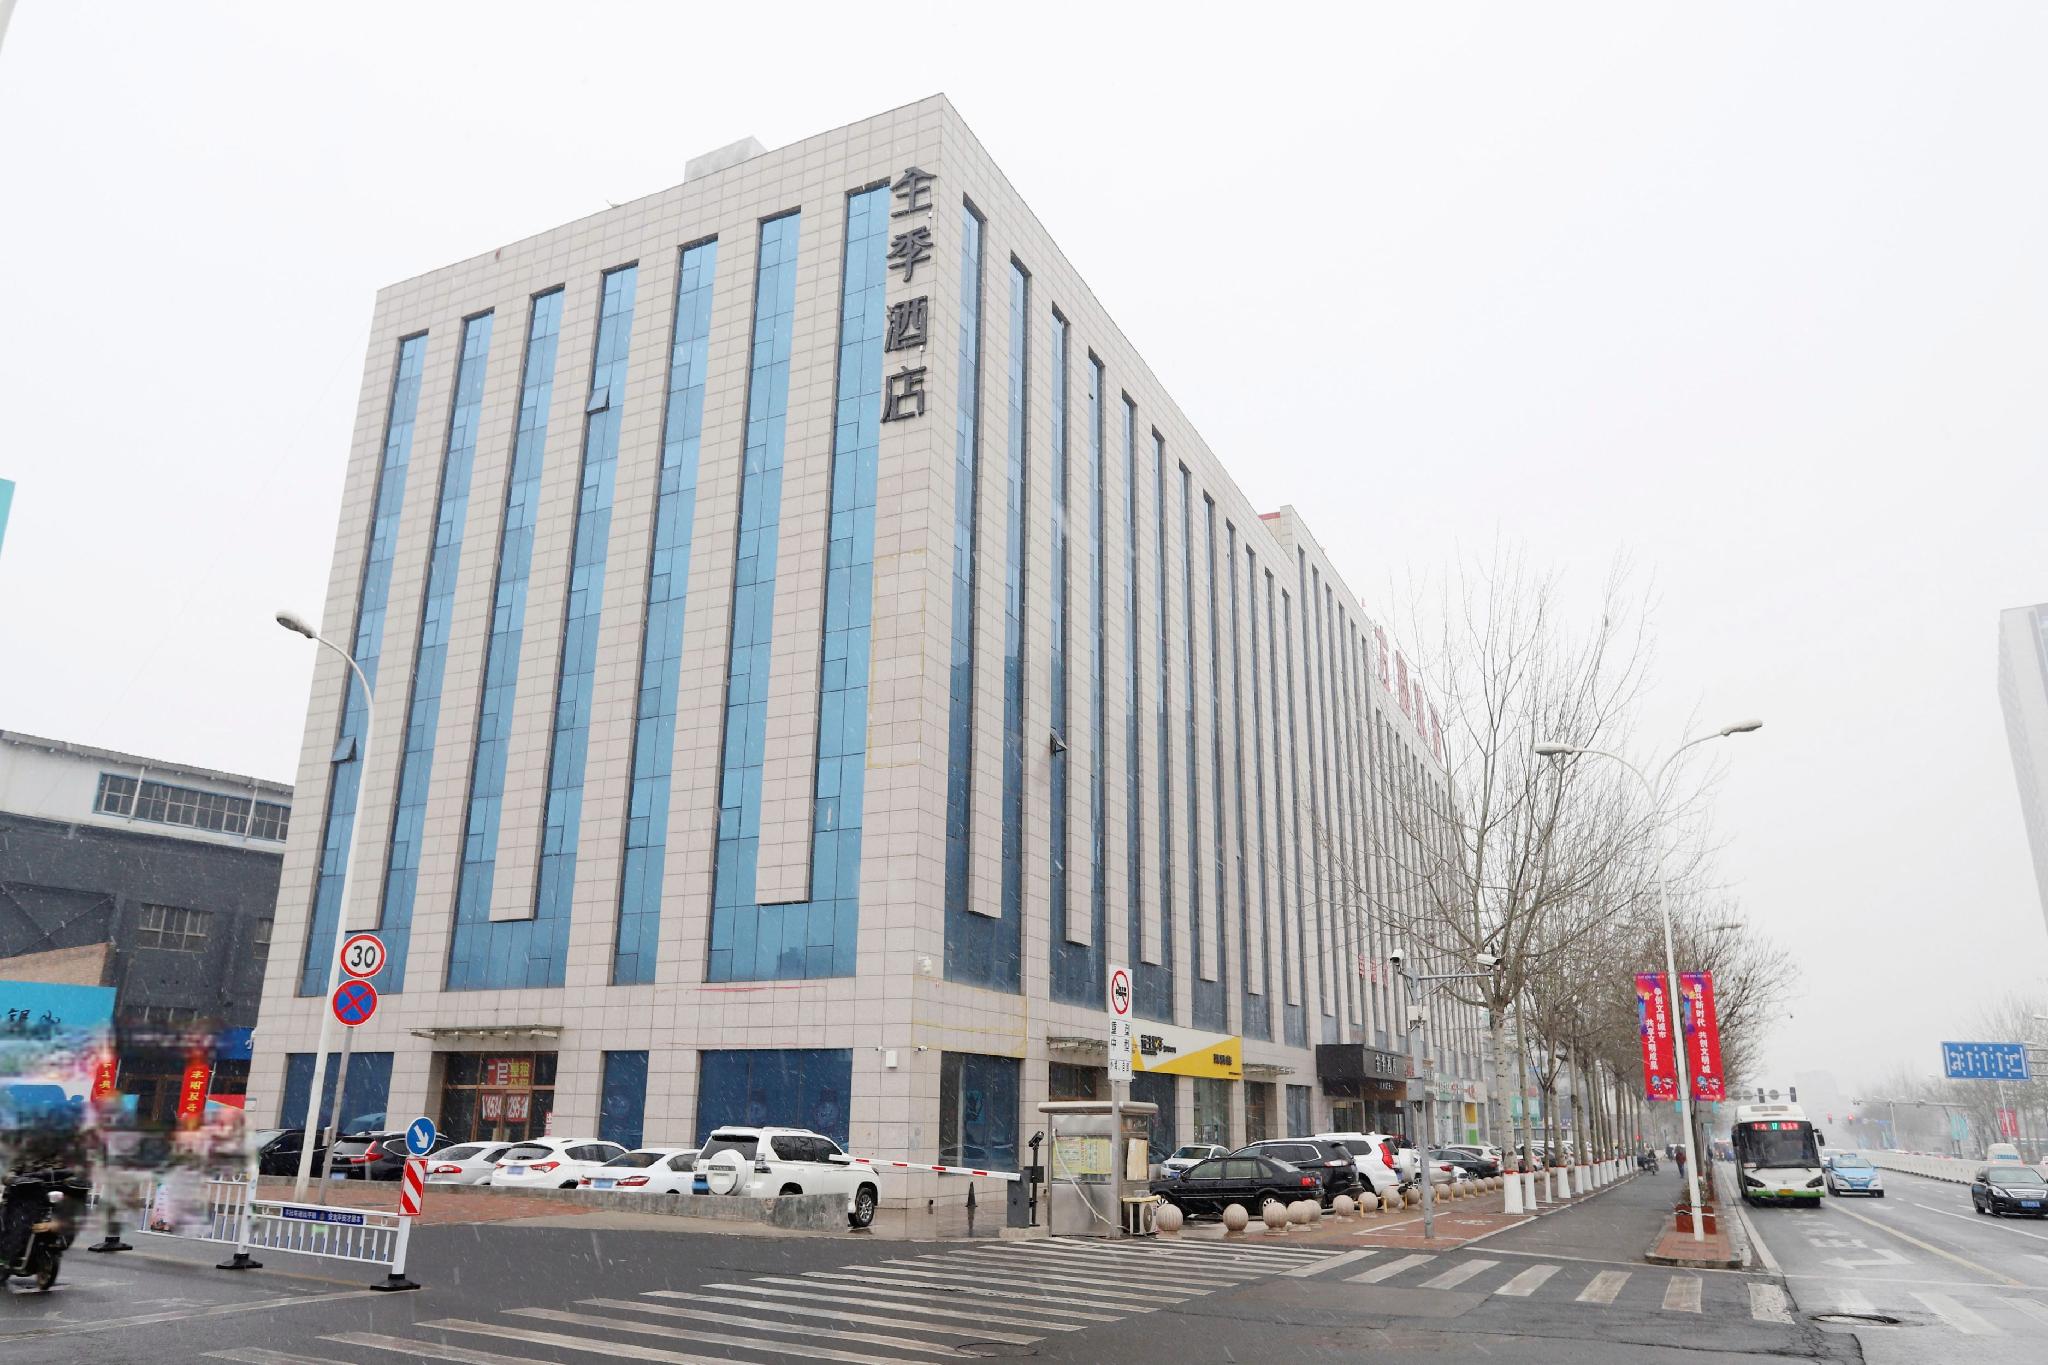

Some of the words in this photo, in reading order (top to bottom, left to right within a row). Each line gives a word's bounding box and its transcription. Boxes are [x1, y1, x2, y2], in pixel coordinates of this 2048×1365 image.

[880, 166, 937, 424] 全季酒店
[350, 944, 377, 969] 30
[1693, 983, 1707, 1027] 奋斗新时代
[1698, 1031, 1711, 1074] 共创文明城
